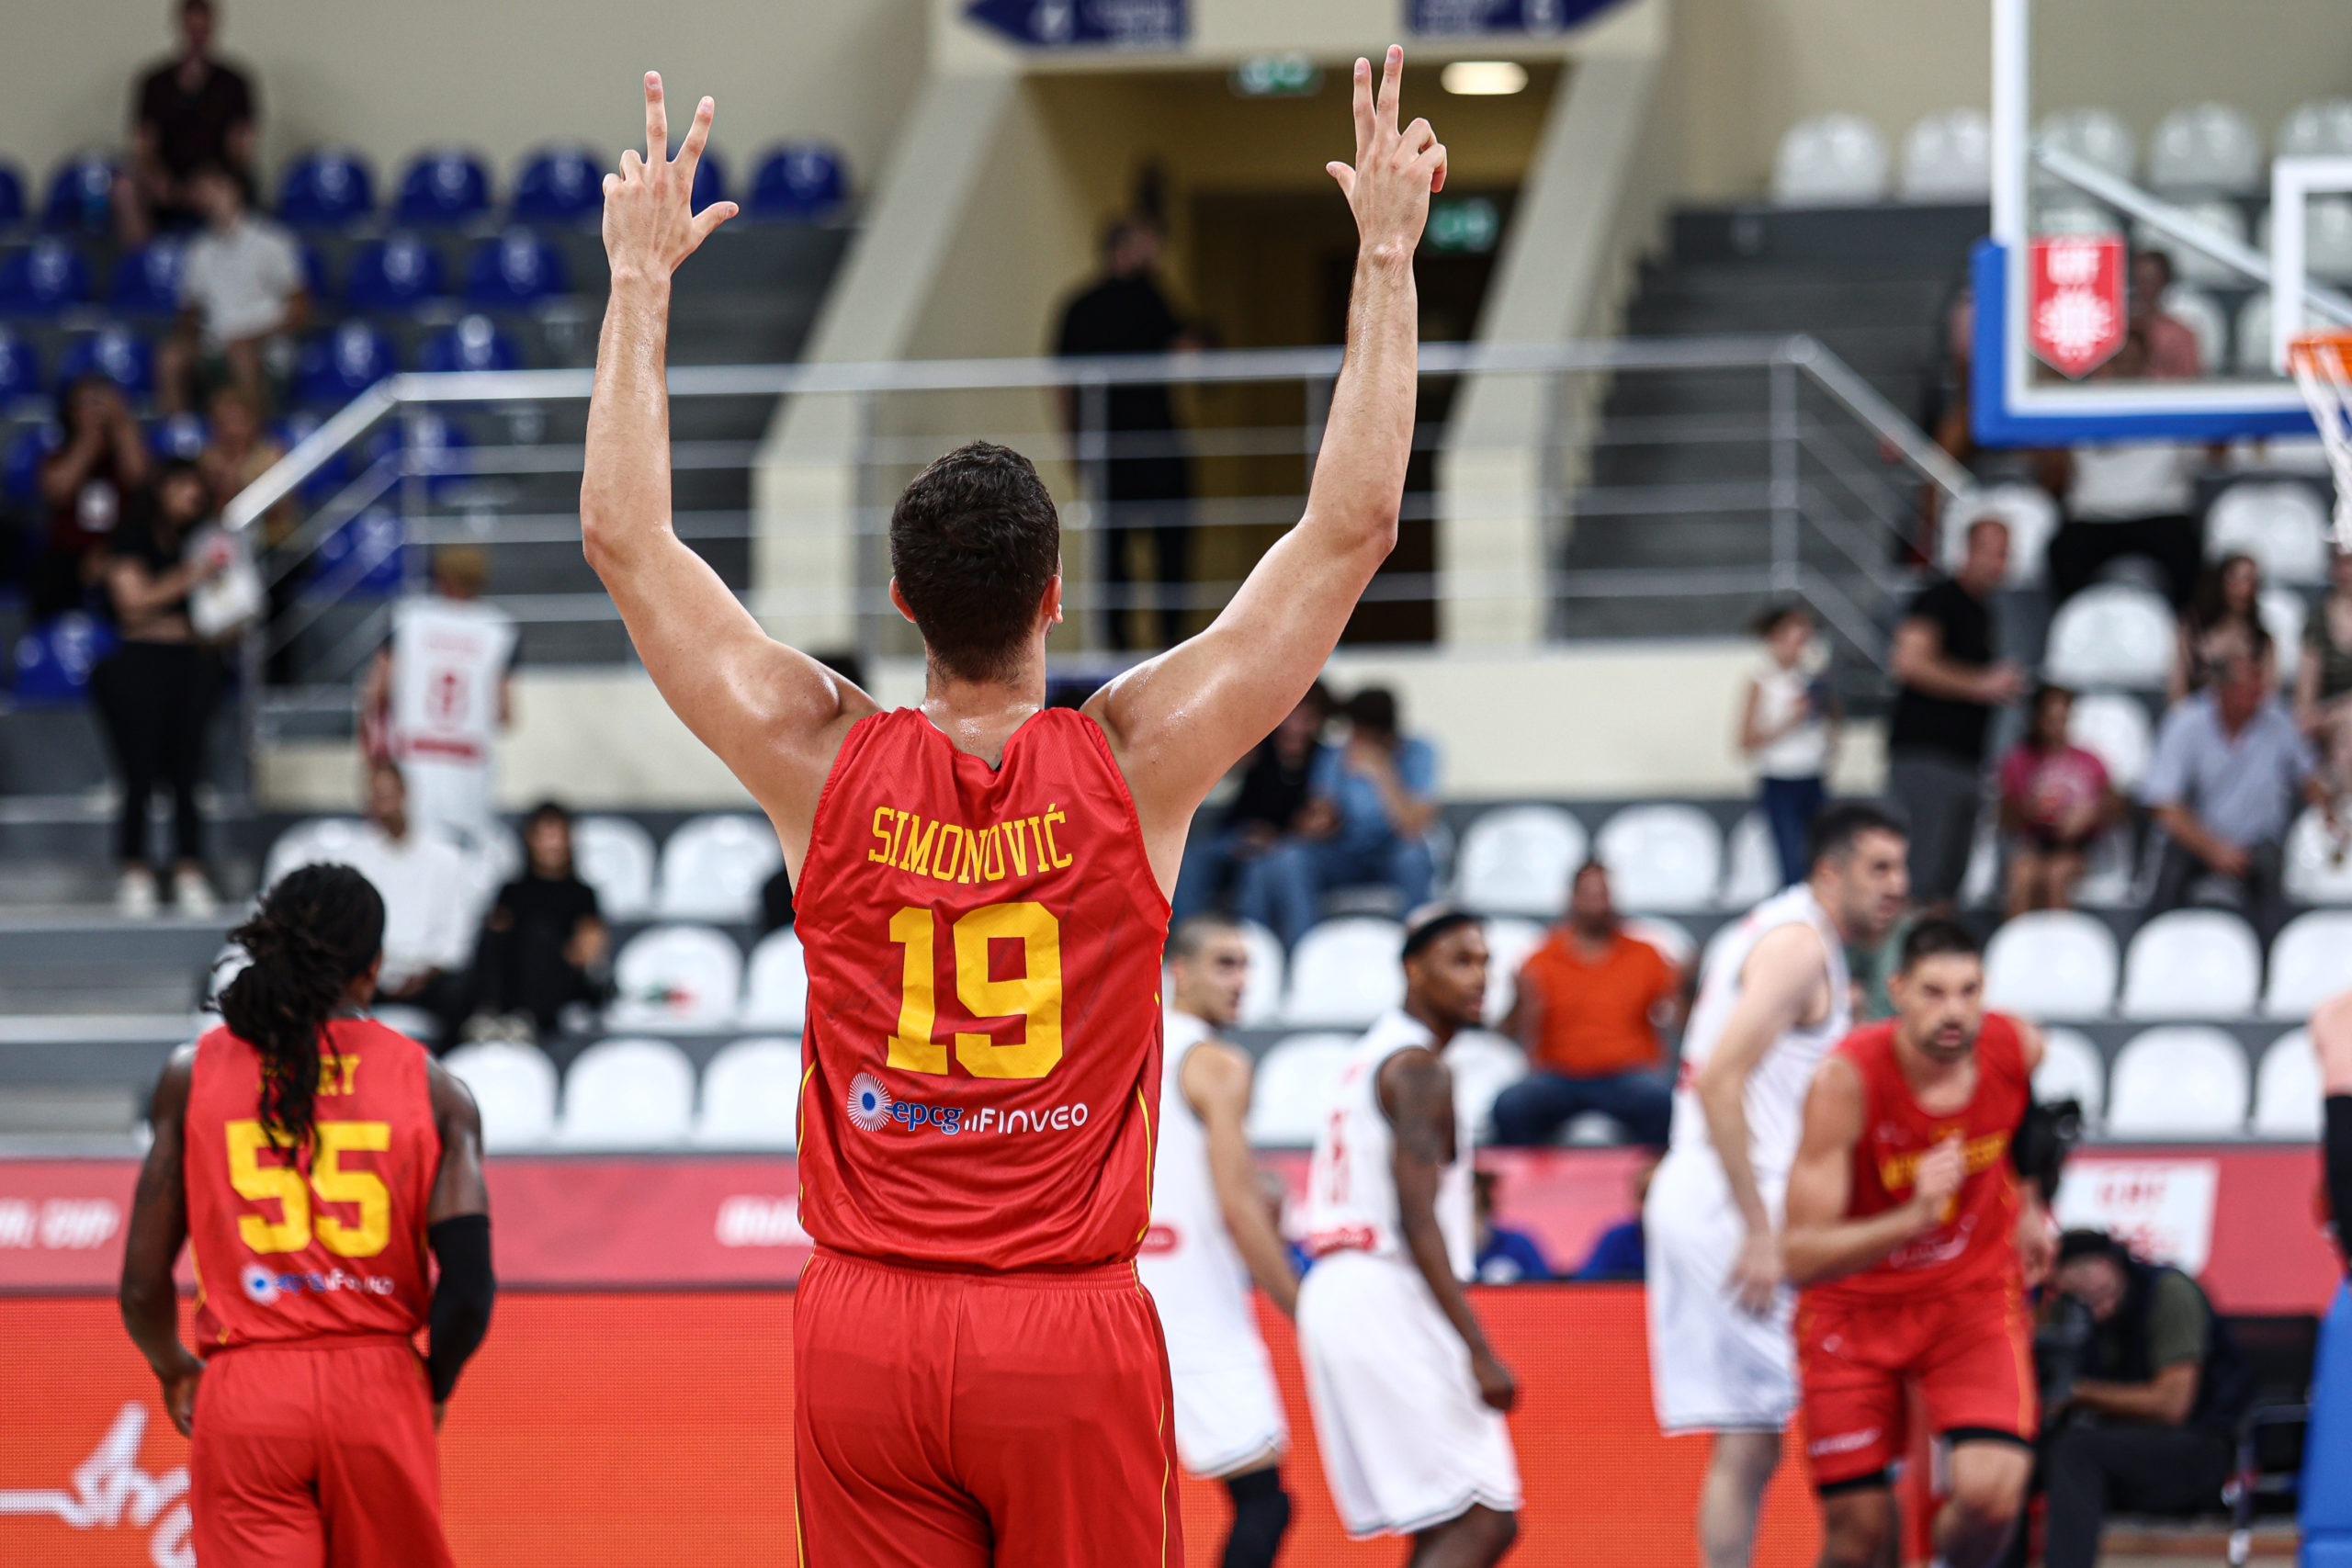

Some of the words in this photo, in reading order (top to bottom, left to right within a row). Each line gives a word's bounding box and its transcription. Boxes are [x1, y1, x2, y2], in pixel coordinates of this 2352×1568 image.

[868, 803, 1073, 884] SIMONOVIĆ
[886, 901, 1064, 1079] 19
[890, 1100, 964, 1134] epcg
[224, 1118, 391, 1258] 55
